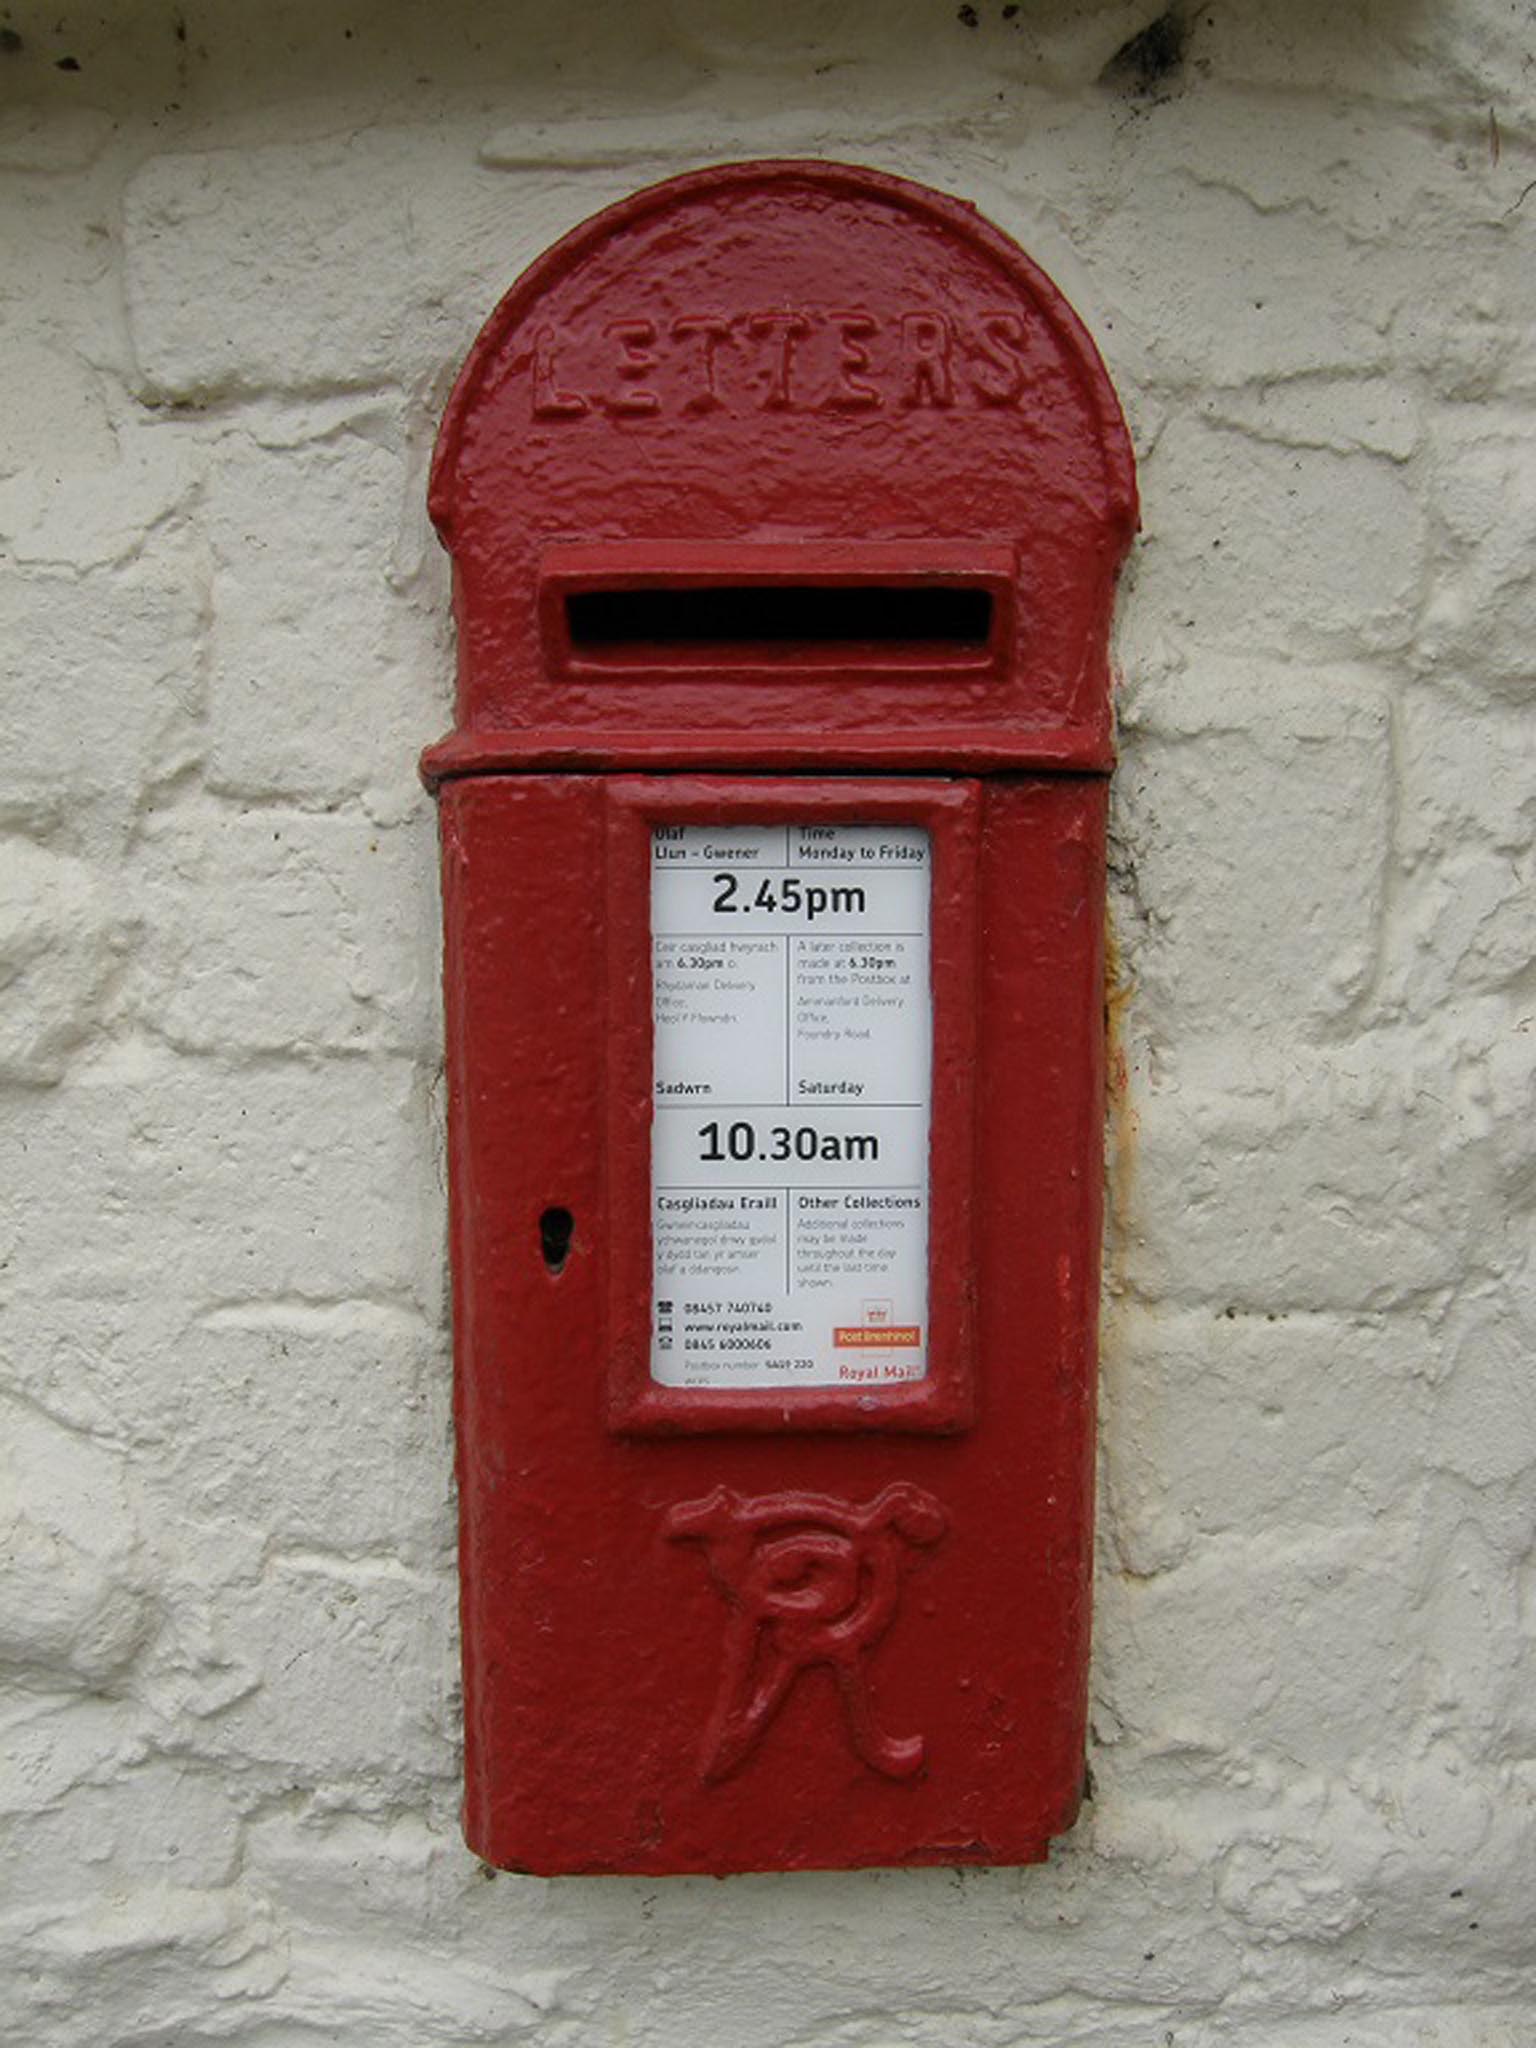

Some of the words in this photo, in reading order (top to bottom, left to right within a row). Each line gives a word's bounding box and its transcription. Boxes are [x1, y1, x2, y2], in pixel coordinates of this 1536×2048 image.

[532, 310, 1030, 422] LETTERS
[800, 827, 836, 840] Time
[655, 846, 687, 859] Llun
[703, 845, 759, 860] Gwener
[799, 845, 855, 862] Monday
[860, 847, 875, 860] to
[879, 845, 925, 862] Friday
[713, 873, 865, 920] 2.45pm
[797, 941, 806, 952] A
[677, 957, 724, 970] 6.30pm
[848, 957, 896, 970] 6.30pm
[828, 975, 848, 984] the
[656, 1081, 712, 1094] Sadwrn
[799, 1080, 864, 1096] Saturday
[699, 1121, 879, 1160] 10.30am
[658, 1196, 735, 1213] Casgliadau
[740, 1196, 778, 1209] Eraill
[799, 1196, 839, 1209] Other
[844, 1196, 921, 1209] Collections
[684, 1303, 722, 1313] 08457
[728, 1302, 772, 1313] 740740
[684, 1320, 803, 1334] www.royalmail.com
[684, 1338, 715, 1350] 0845
[719, 1338, 772, 1350] 6000606
[839, 1364, 880, 1381] Royal
